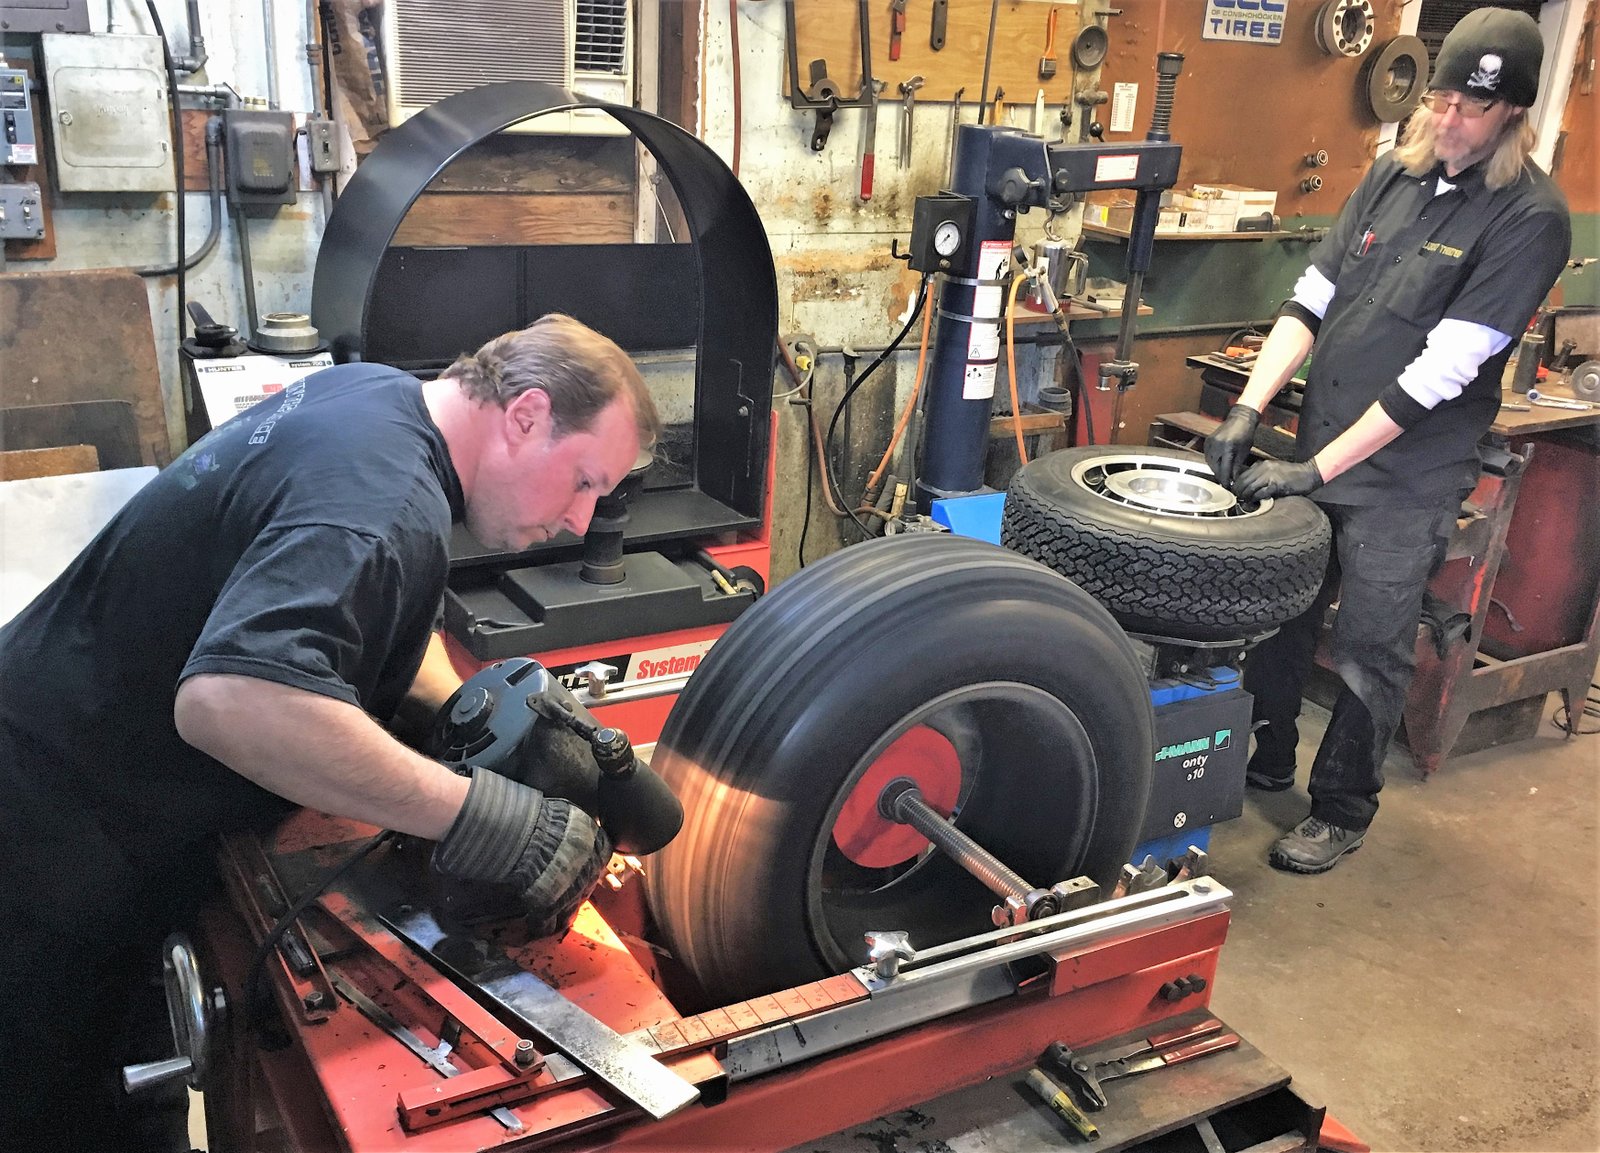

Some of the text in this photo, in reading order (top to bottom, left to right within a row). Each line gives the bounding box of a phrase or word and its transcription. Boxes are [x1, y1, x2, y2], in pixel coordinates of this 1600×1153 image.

[1222, 10, 1283, 21] CONSHOHOCKEN
[1210, 18, 1282, 38] TIRES
[637, 654, 701, 680] System
